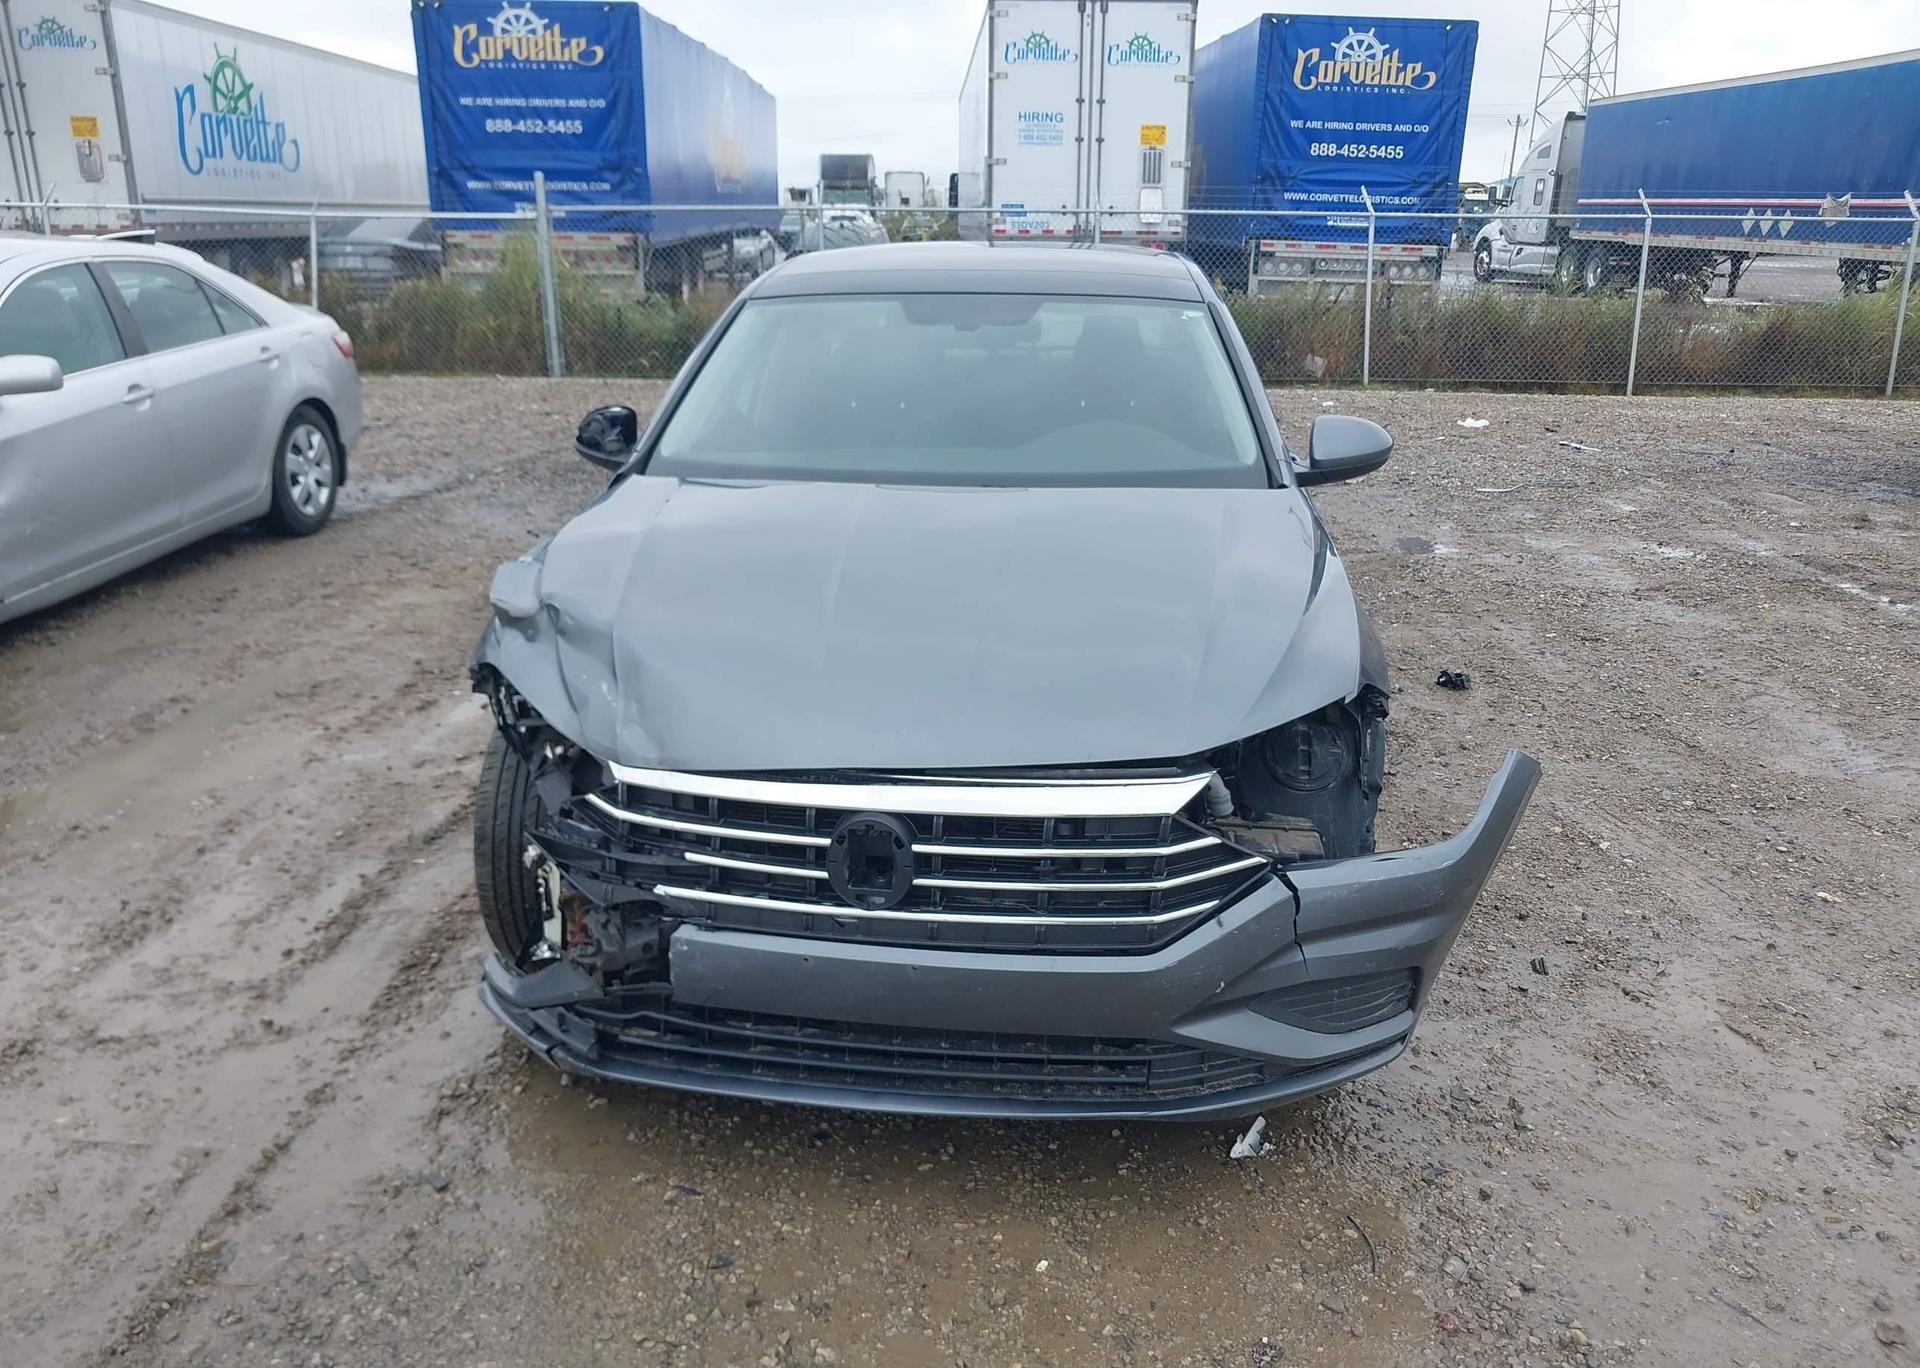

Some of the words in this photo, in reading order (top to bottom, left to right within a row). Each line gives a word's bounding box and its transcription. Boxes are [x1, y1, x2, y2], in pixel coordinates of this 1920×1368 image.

[17, 27, 97, 51] Corvette
[453, 23, 605, 69] Corvette
[1004, 41, 1079, 64] Corvette
[1107, 43, 1181, 66] Corvette
[480, 61, 546, 70] LOGISTICS
[1293, 47, 1437, 91] Corvette
[1317, 84, 1379, 94] LOGISTICS
[1386, 86, 1411, 95] INC.
[459, 97, 474, 106] WE
[476, 97, 493, 107] ARE
[495, 98, 527, 108] HIRING
[528, 99, 567, 109] DRIVERS
[568, 99, 588, 109] AND
[1018, 111, 1065, 123] HIRING
[174, 83, 300, 176] Corvette
[485, 119, 584, 134] 888-452-5455
[1290, 119, 1305, 129] WE
[1305, 119, 1323, 130] ARE
[1324, 120, 1354, 131] HIRING
[1355, 122, 1393, 132] DRIVERS
[1393, 123, 1413, 133] AND
[1413, 124, 1430, 134] O/O
[1310, 142, 1405, 160] 888-452-5455
